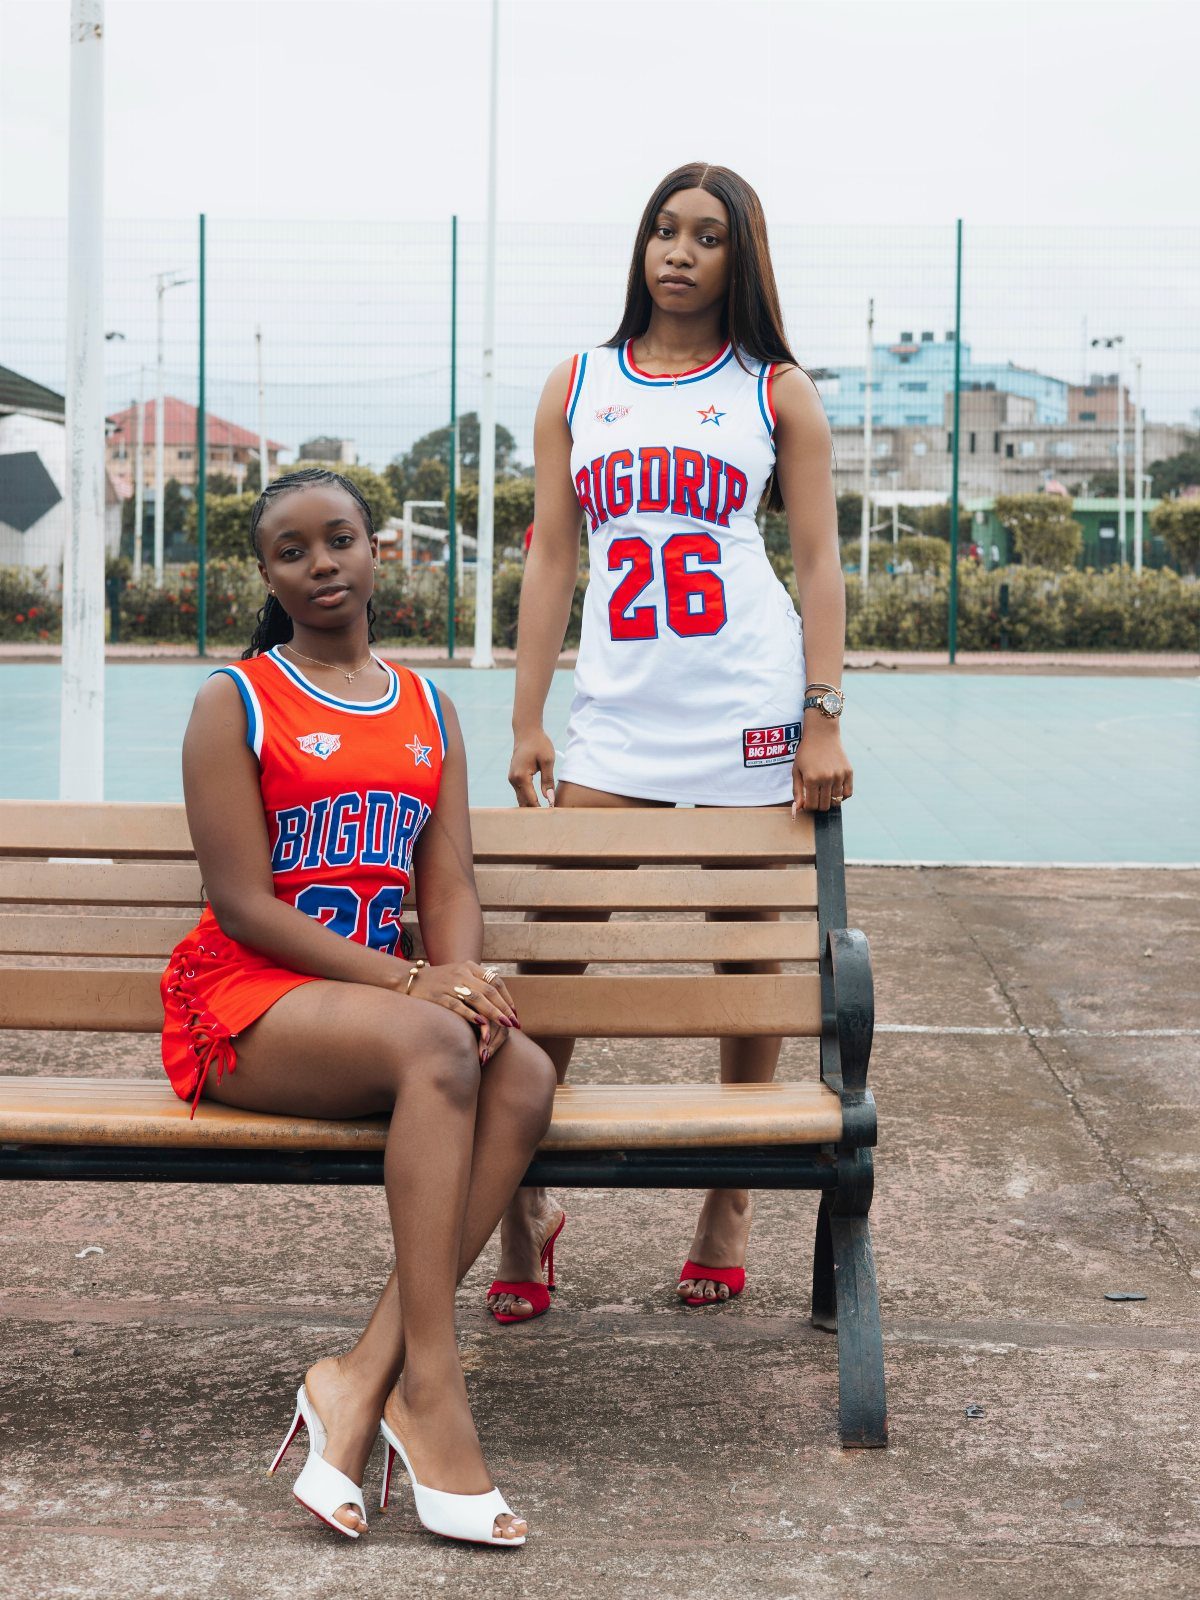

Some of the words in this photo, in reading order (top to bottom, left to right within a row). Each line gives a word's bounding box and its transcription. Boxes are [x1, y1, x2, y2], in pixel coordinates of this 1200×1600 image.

[607, 532, 728, 641] 26
[748, 746, 764, 757] BIG
[766, 744, 786, 756] DRIP
[271, 790, 432, 877] BIGDRI
[295, 884, 405, 956] 26
